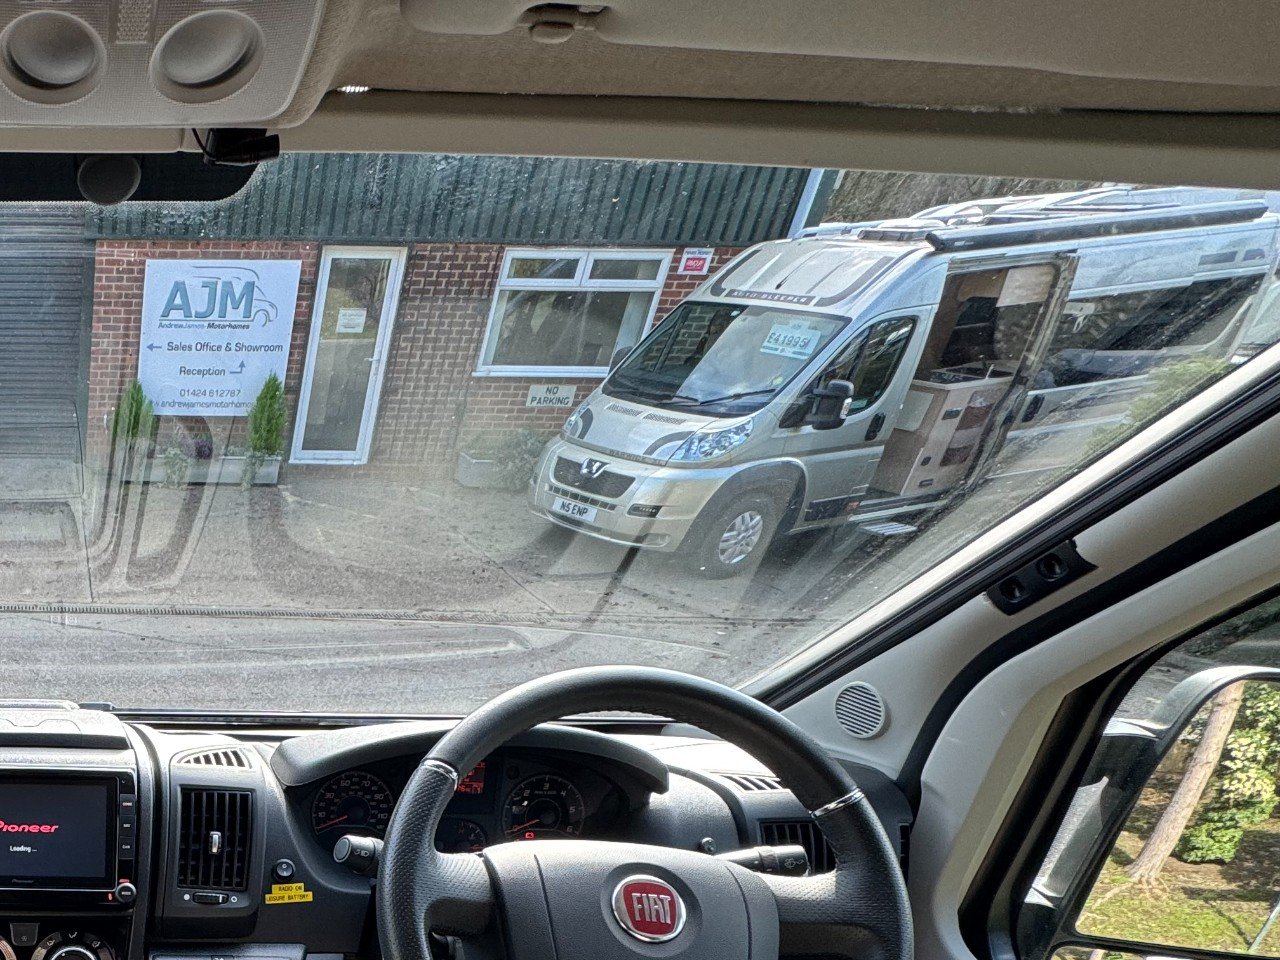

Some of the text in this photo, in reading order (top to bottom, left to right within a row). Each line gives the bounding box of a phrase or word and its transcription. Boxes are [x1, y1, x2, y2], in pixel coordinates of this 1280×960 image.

[160, 280, 256, 319] AJM
[167, 341, 283, 352] Sales Office & Showroom
[179, 366, 226, 378] Reception
[179, 389, 207, 398] 01424
[546, 386, 559, 395] NO
[530, 396, 570, 406] PARKING
[9, 845, 32, 853] Loading
[631, 892, 671, 925] FIAT
